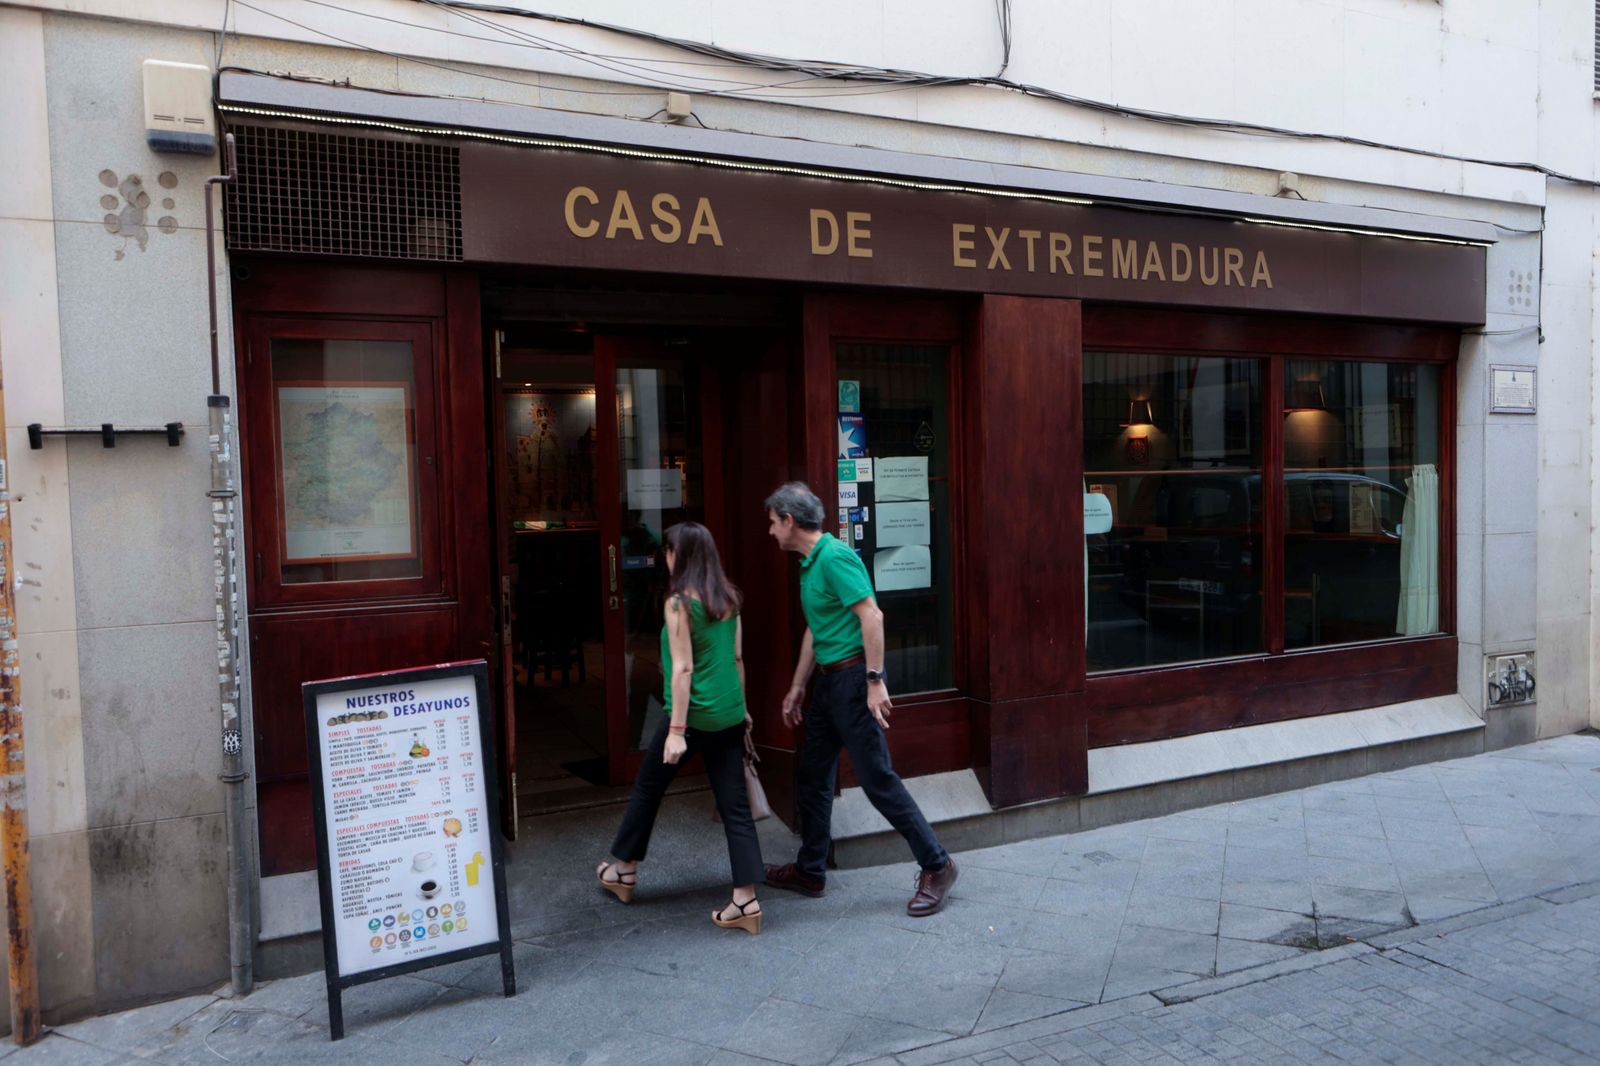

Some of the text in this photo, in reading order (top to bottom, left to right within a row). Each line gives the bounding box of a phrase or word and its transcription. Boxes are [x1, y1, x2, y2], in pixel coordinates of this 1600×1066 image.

[565, 187, 1273, 287] CASA DE EXTREMADURA
[839, 491, 856, 499] VISA
[346, 690, 415, 709] NUESTROS
[393, 696, 470, 717] DESAYUNOS
[357, 725, 382, 734] TOSTADAS
[332, 762, 396, 777] COMPUESTAS TOSTADAS
[333, 783, 398, 798] ESPECIALES TOSTADAS
[336, 814, 429, 835] ESPECIALES COMPUESTAS TOSTADAS
[339, 858, 360, 867] BEBIDAS
